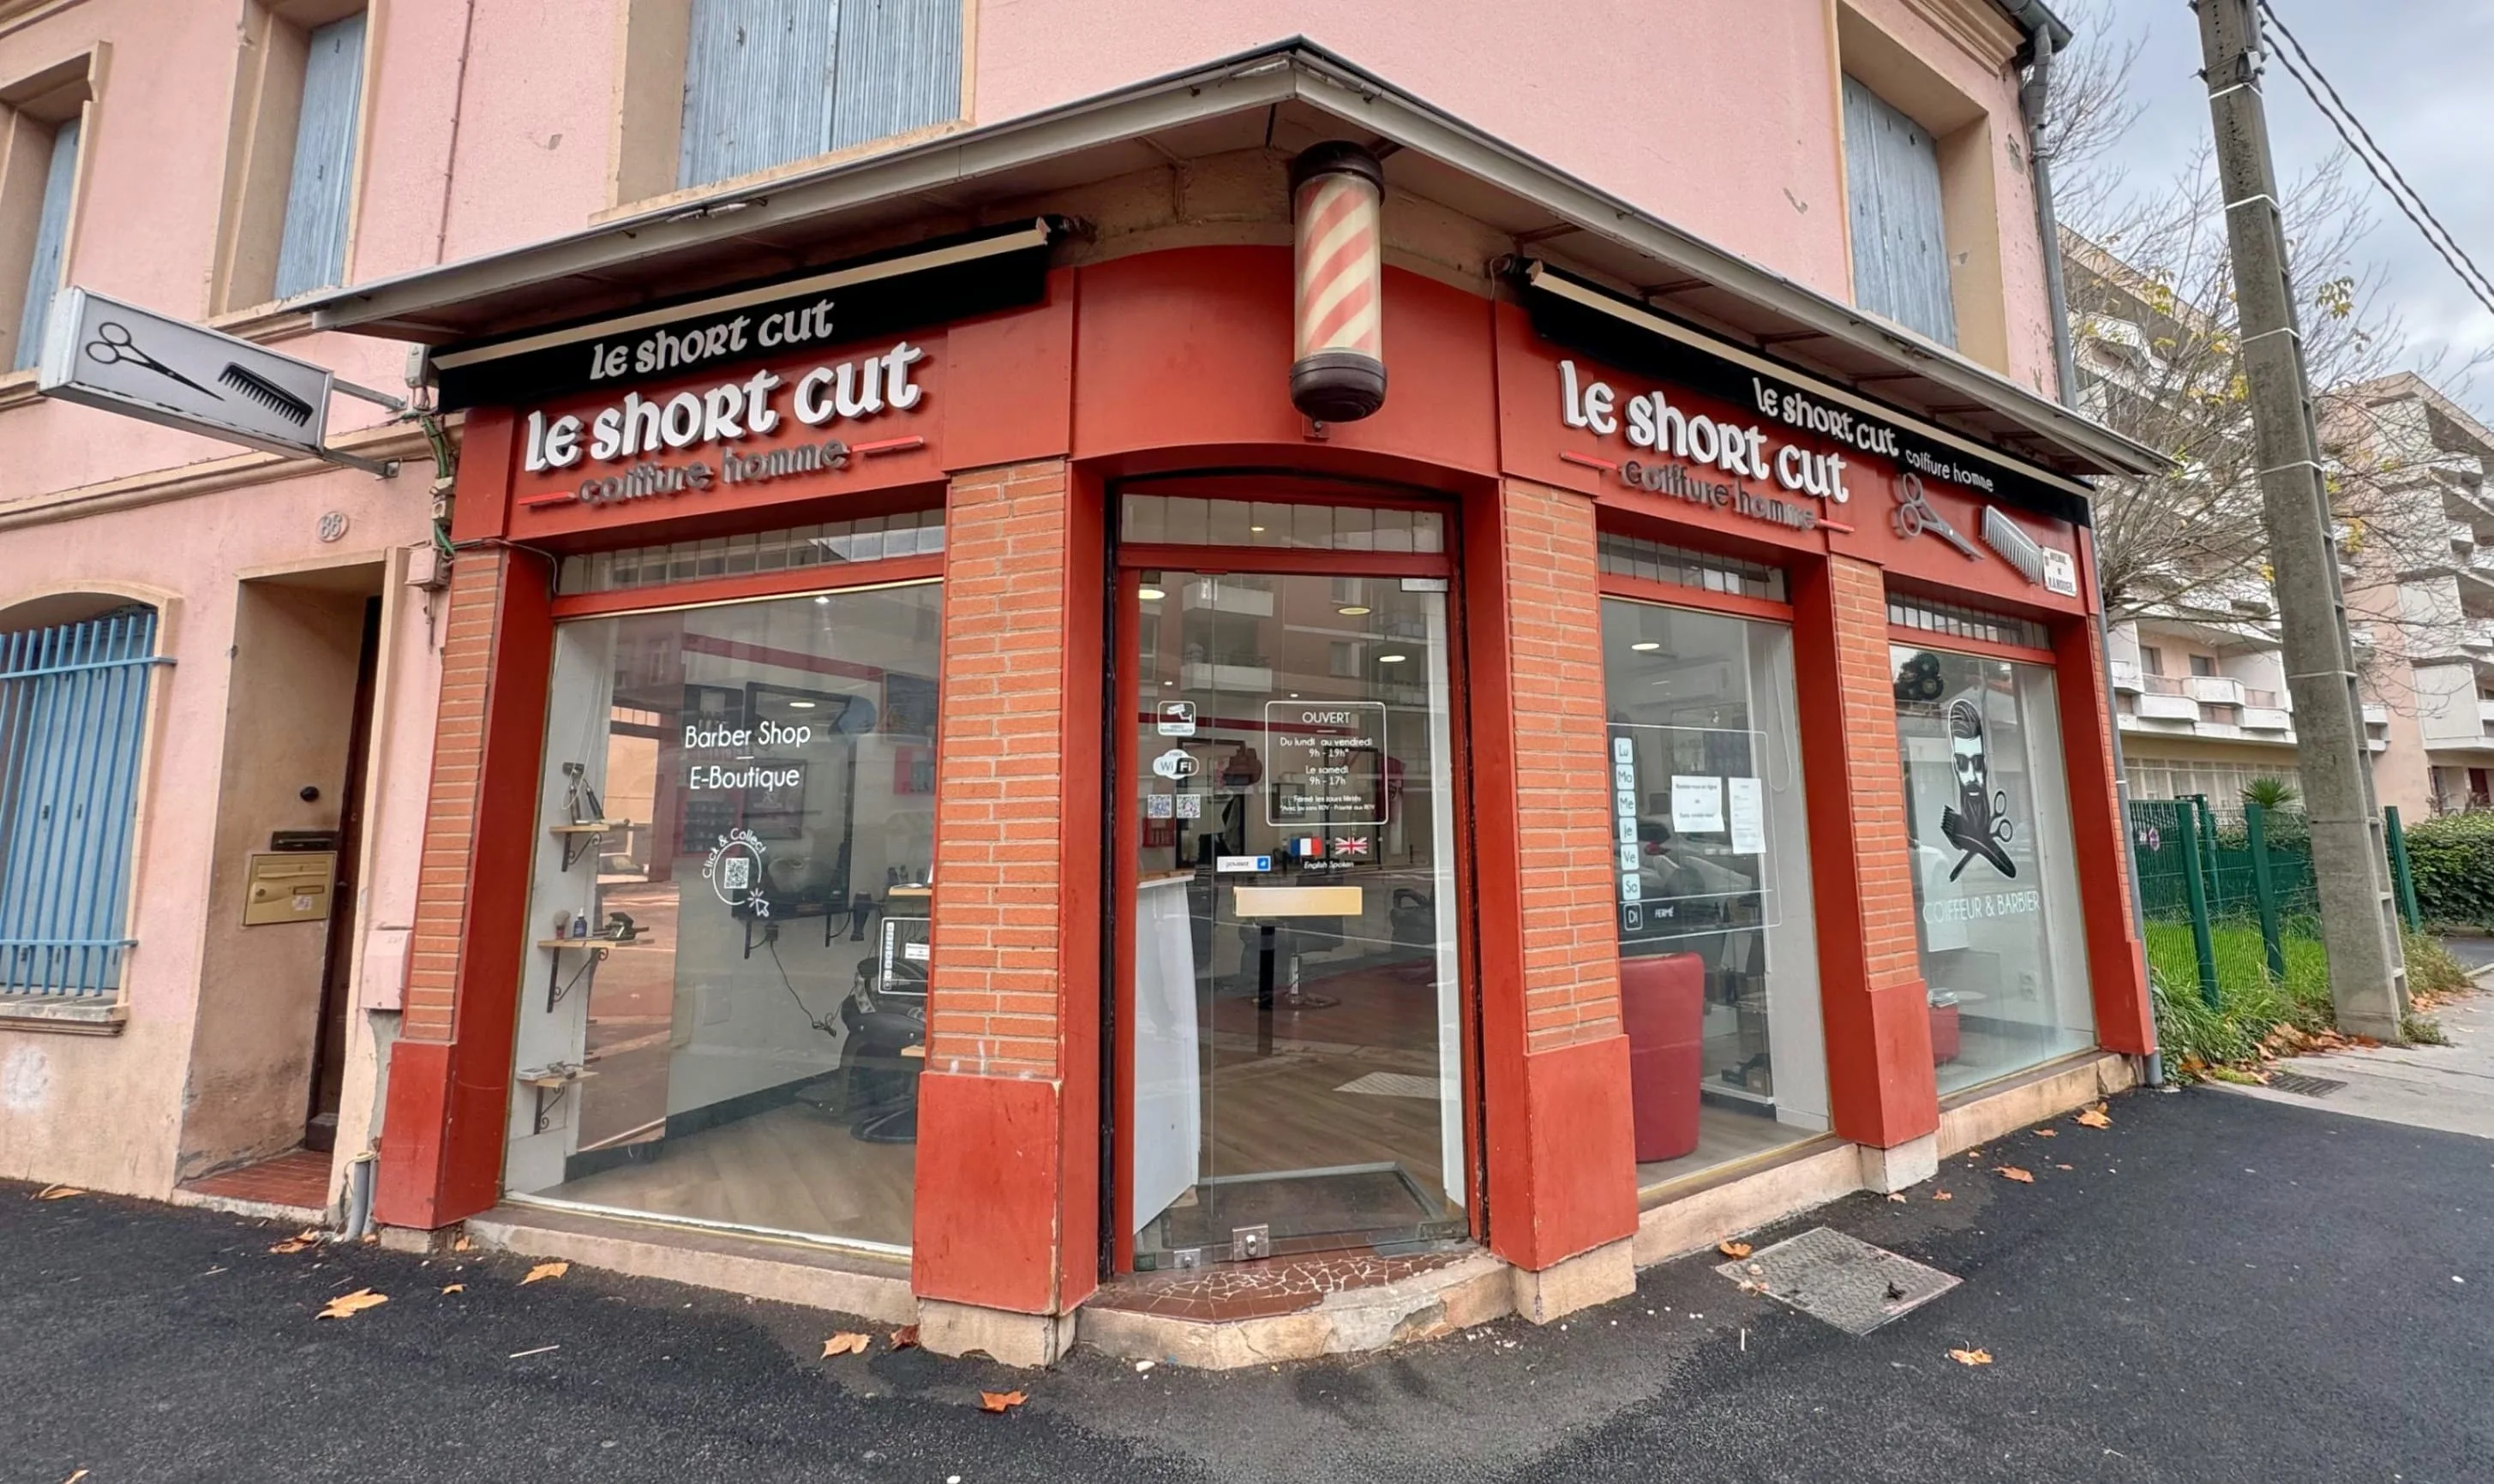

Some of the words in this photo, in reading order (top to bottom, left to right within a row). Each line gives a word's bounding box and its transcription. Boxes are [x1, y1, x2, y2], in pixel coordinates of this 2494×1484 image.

[590, 344, 629, 380] le
[758, 299, 835, 346] cut
[525, 410, 585, 471] le
[794, 341, 924, 425] cut
[1753, 377, 1778, 416] le
[1857, 423, 1899, 457] cut
[1559, 360, 1617, 435] le
[1775, 444, 1850, 504] cut
[579, 460, 714, 505] coiffure
[722, 439, 850, 484] homme
[1905, 449, 1951, 479] coiffure
[1622, 460, 1730, 507] coiffure
[1732, 480, 1820, 530] homme
[1302, 711, 1352, 724] OUVERT
[685, 723, 752, 748] Barber
[758, 720, 812, 749] Shop
[1280, 737, 1292, 746] Du
[1294, 737, 1316, 747] lundi
[1334, 737, 1373, 747] vendredi
[1309, 748, 1320, 757] 9h
[1618, 744, 1629, 757] Lu
[690, 765, 800, 792] E-Boutique
[1305, 765, 1316, 774] Le
[1318, 765, 1349, 775] samedi
[1310, 776, 1320, 785] 9h
[1329, 775, 1346, 785] 17h
[1620, 797, 1634, 810] Me
[702, 847, 720, 878] Click
[718, 835, 728, 847] &
[730, 828, 767, 854] Collect
[1623, 850, 1636, 864] Ve
[1922, 896, 1982, 925] COIFFEUR
[1985, 895, 1995, 918] &
[1998, 889, 2041, 916] BARBIER
